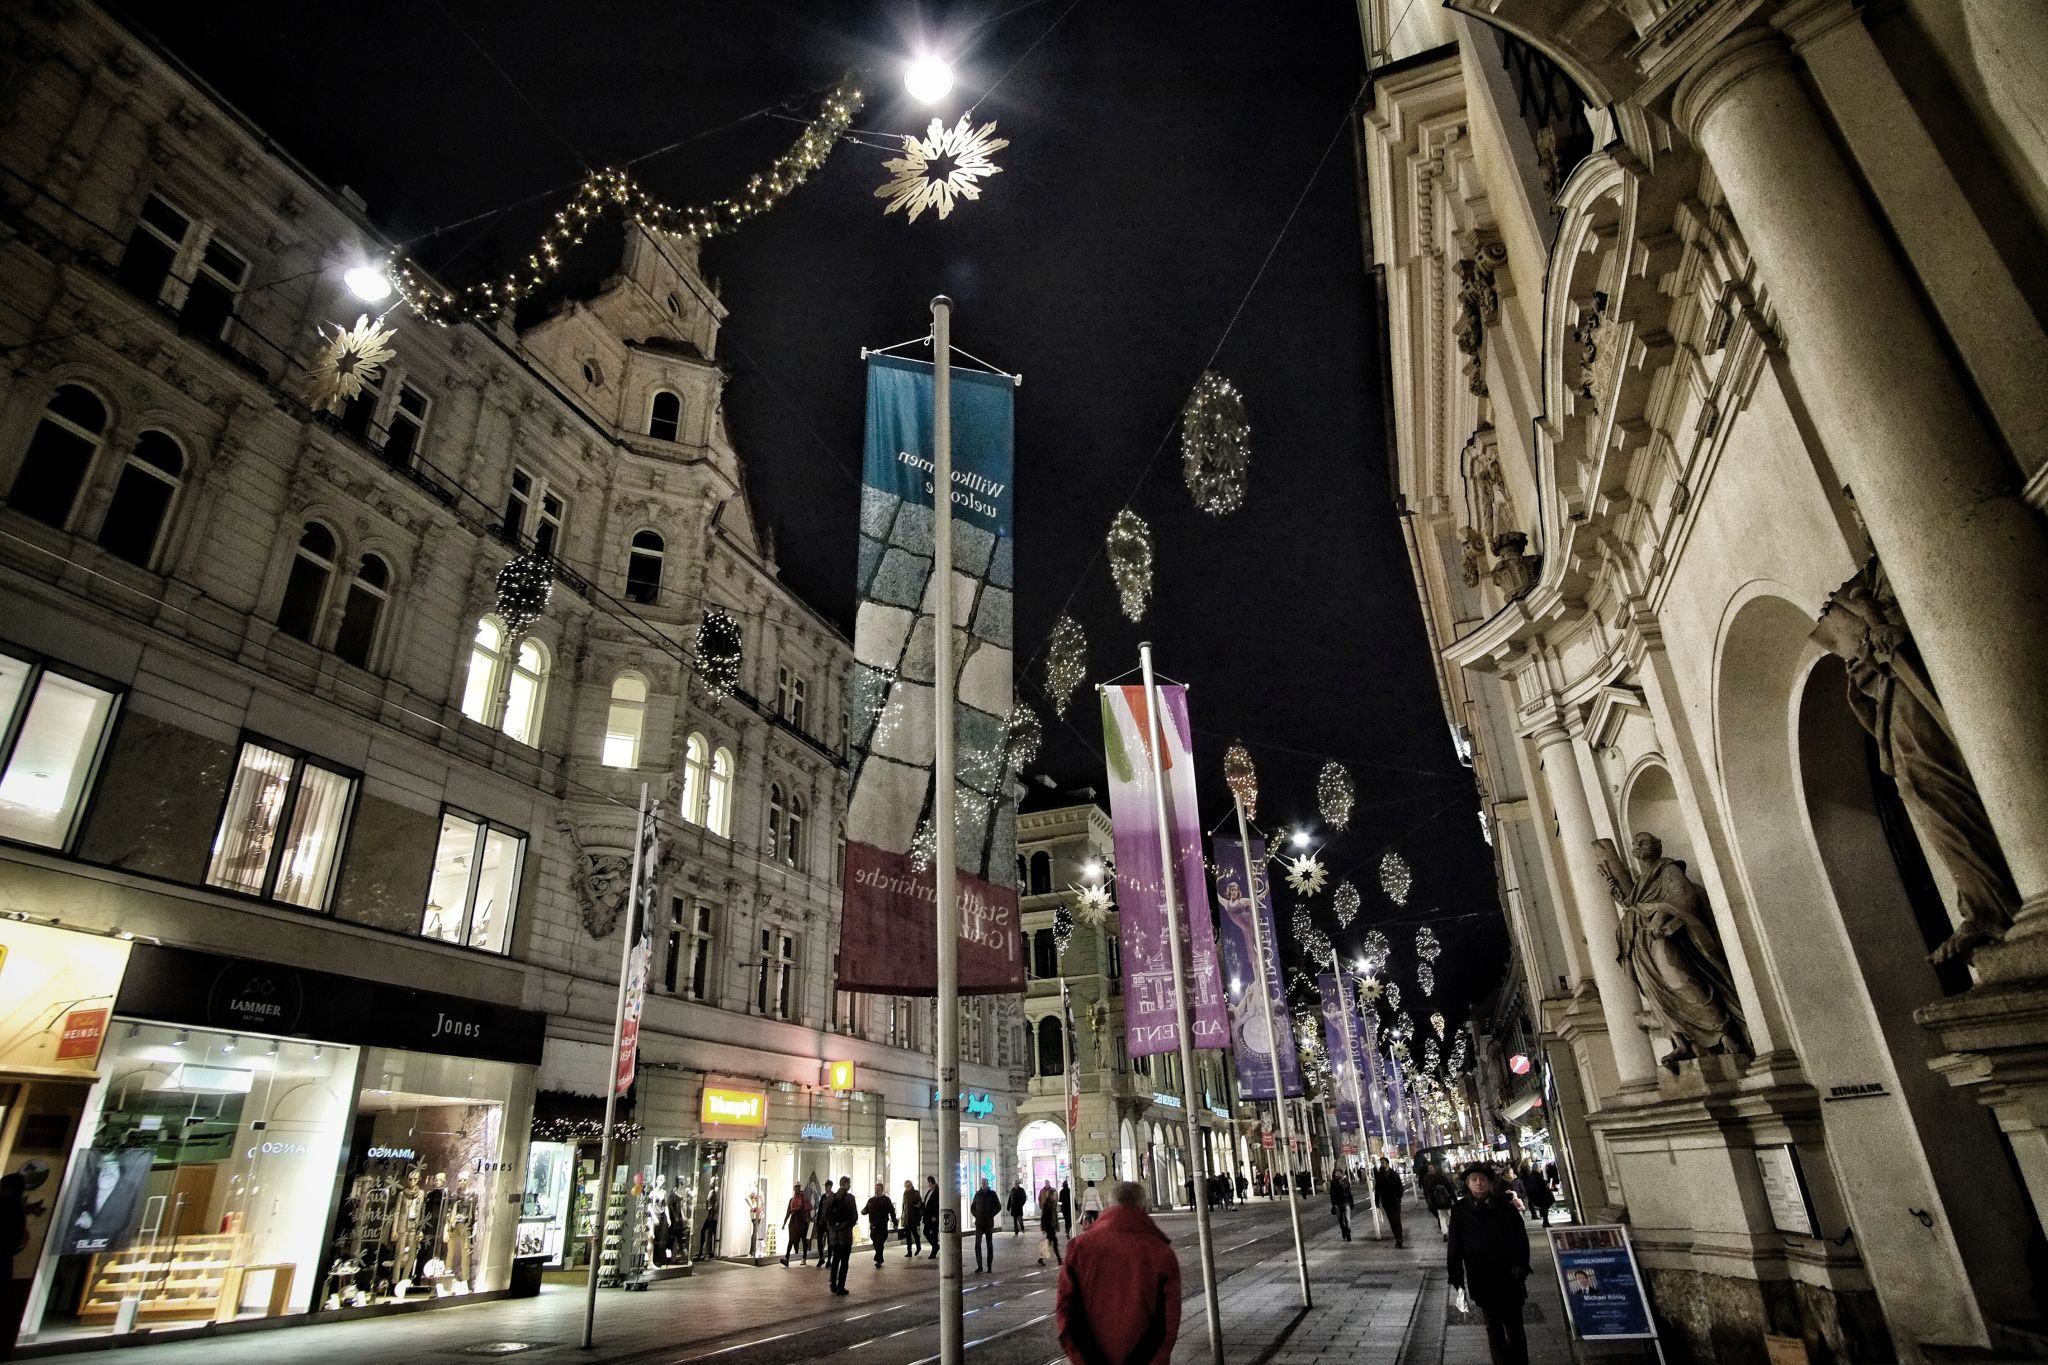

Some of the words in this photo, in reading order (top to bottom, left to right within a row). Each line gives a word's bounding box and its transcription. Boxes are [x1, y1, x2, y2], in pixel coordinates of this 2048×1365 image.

[229, 999, 281, 1016] LAMMER
[431, 1012, 481, 1038] Jones
[1829, 1083, 1884, 1097] EINGANG
[709, 1095, 751, 1120] Triumph
[473, 1158, 513, 1175] Jones
